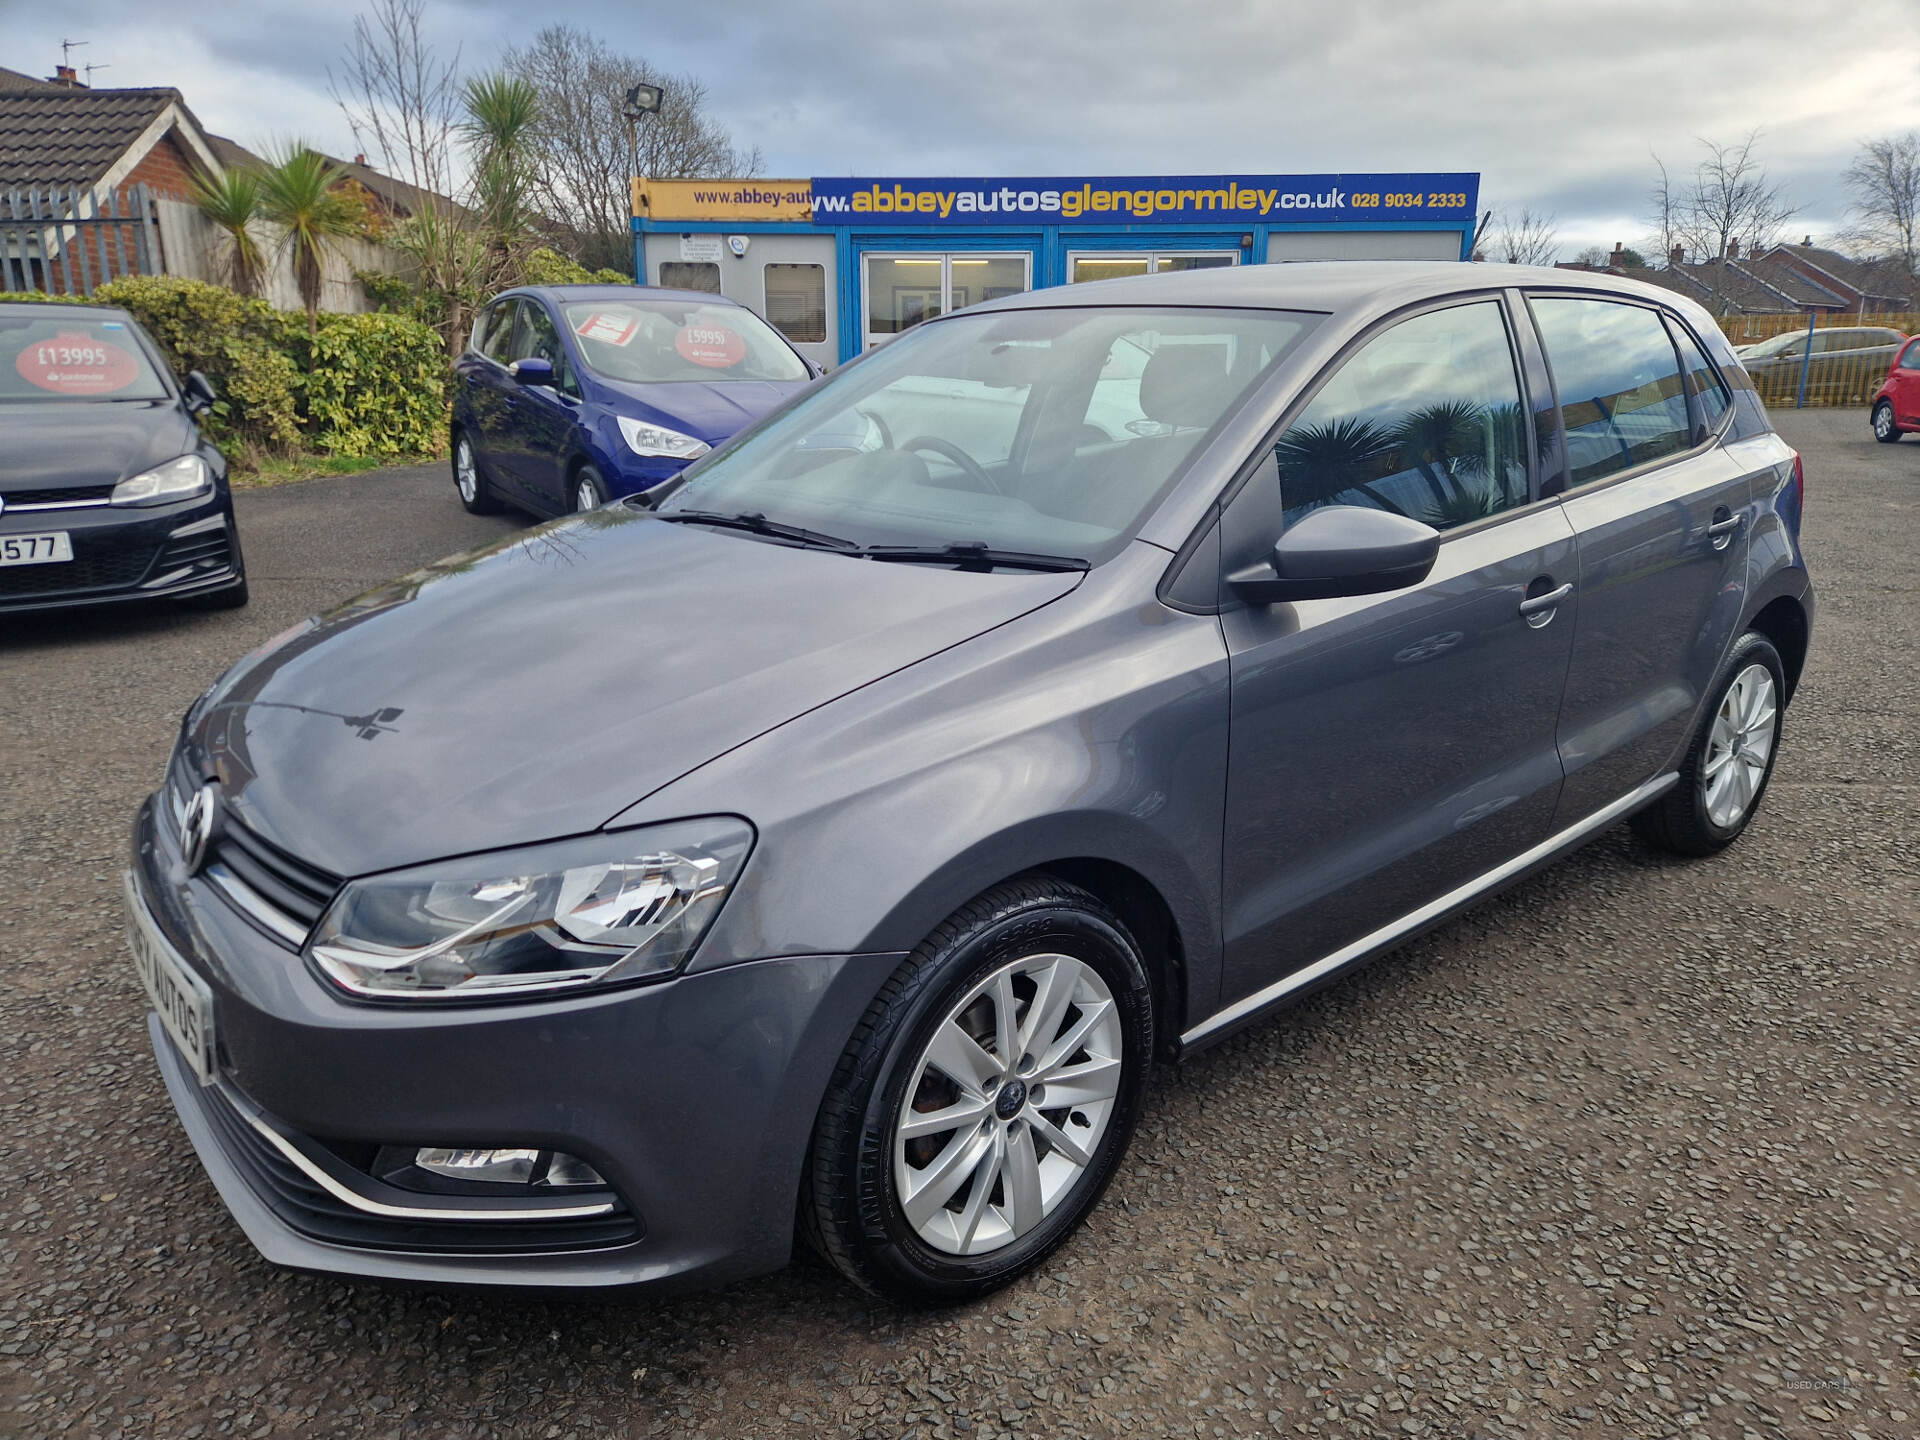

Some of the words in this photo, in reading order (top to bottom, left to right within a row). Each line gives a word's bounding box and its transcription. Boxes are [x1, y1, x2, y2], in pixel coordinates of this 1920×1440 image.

[1351, 192, 1379, 208] 028
[1385, 192, 1423, 208] 9034
[1427, 192, 1467, 208] 2333
[38, 347, 106, 365] £13995
[0, 536, 55, 560] 577
[153, 955, 198, 1054] AUTOS
